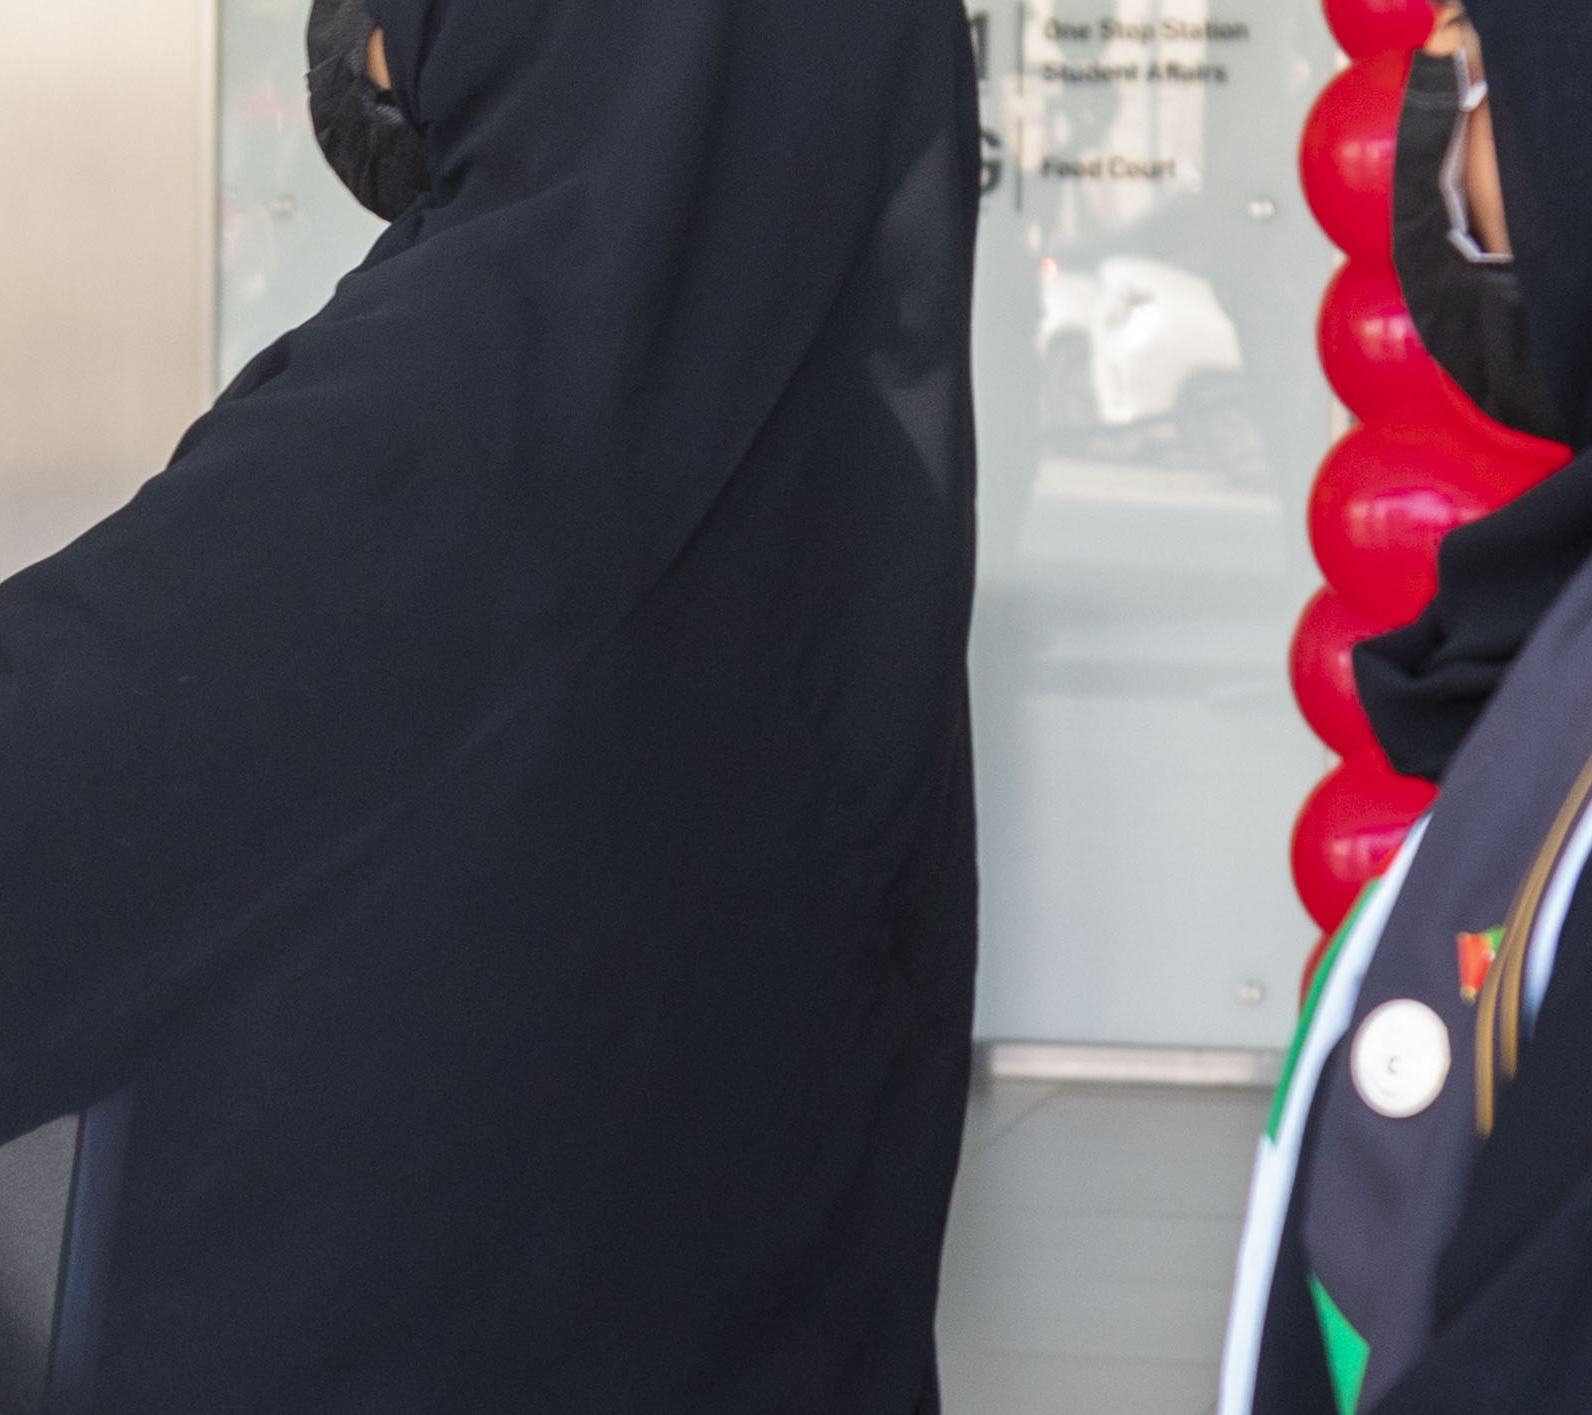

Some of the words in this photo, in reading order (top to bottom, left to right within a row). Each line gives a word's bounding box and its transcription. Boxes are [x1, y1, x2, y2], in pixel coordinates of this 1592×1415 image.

[1043, 17, 1092, 41] One
[1099, 15, 1155, 44] Stop
[1162, 17, 1250, 41] Station
[1042, 61, 1138, 83] Student
[1146, 61, 1228, 83] Affairs
[1042, 155, 1102, 179] Food
[1108, 155, 1176, 179] Court
